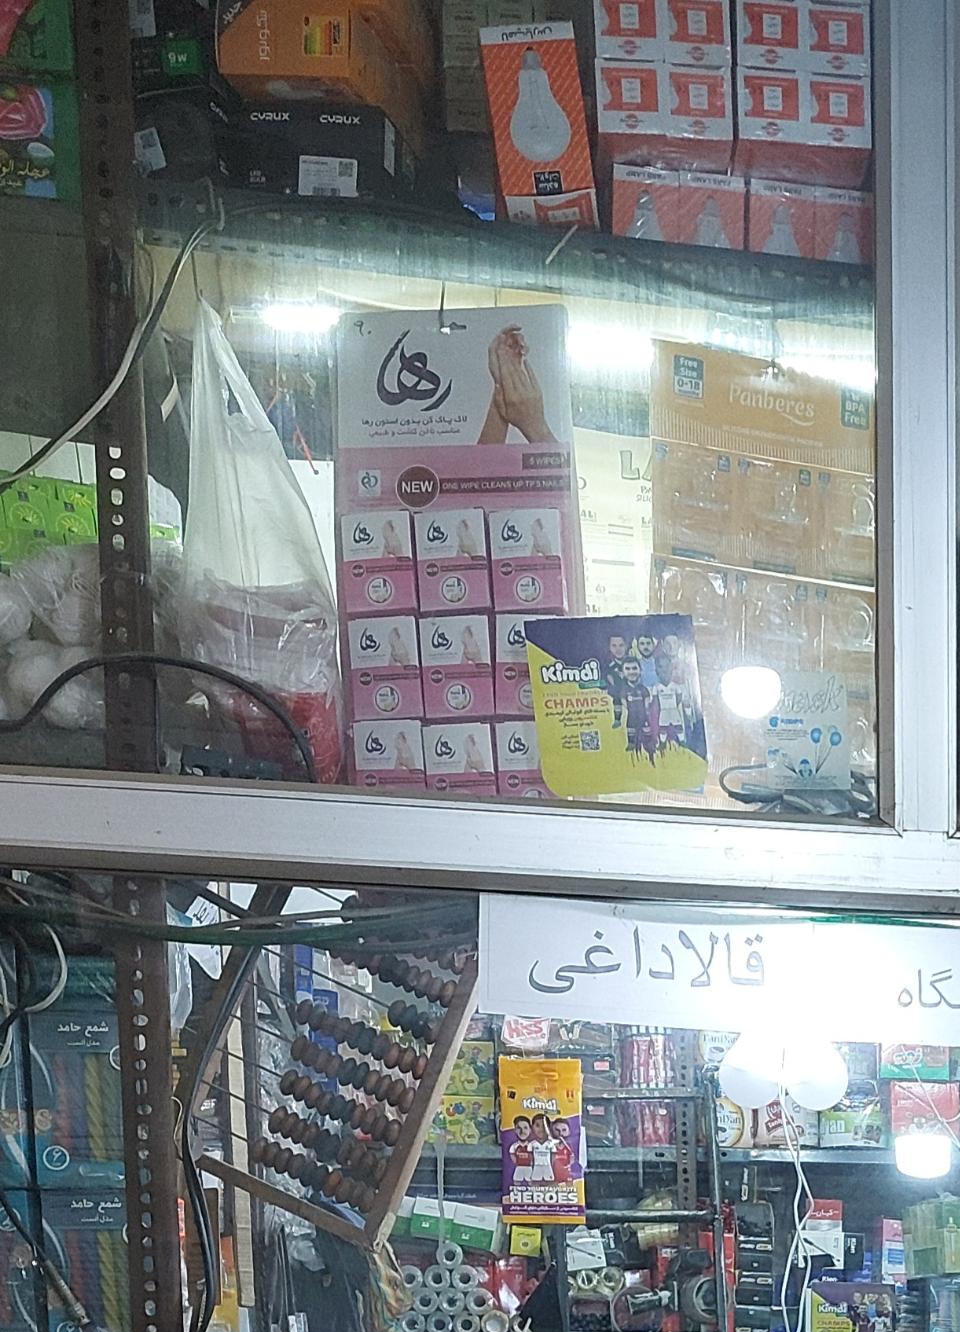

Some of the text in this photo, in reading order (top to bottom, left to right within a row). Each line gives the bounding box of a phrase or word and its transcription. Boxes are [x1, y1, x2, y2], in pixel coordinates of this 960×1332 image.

[250, 111, 290, 121] CYRUX
[319, 114, 361, 125] CYRUX
[376, 328, 453, 412] رها
[729, 384, 816, 418] Panberes
[845, 401, 866, 412] BPA
[844, 412, 867, 427] Free
[401, 480, 434, 493] NEW
[481, 481, 512, 489] CLEANS
[540, 659, 600, 683] Kimdi
[544, 697, 609, 710] CHAMPS
[84, 1022, 110, 1035] شمع
[510, 1191, 578, 1205] HEROES
